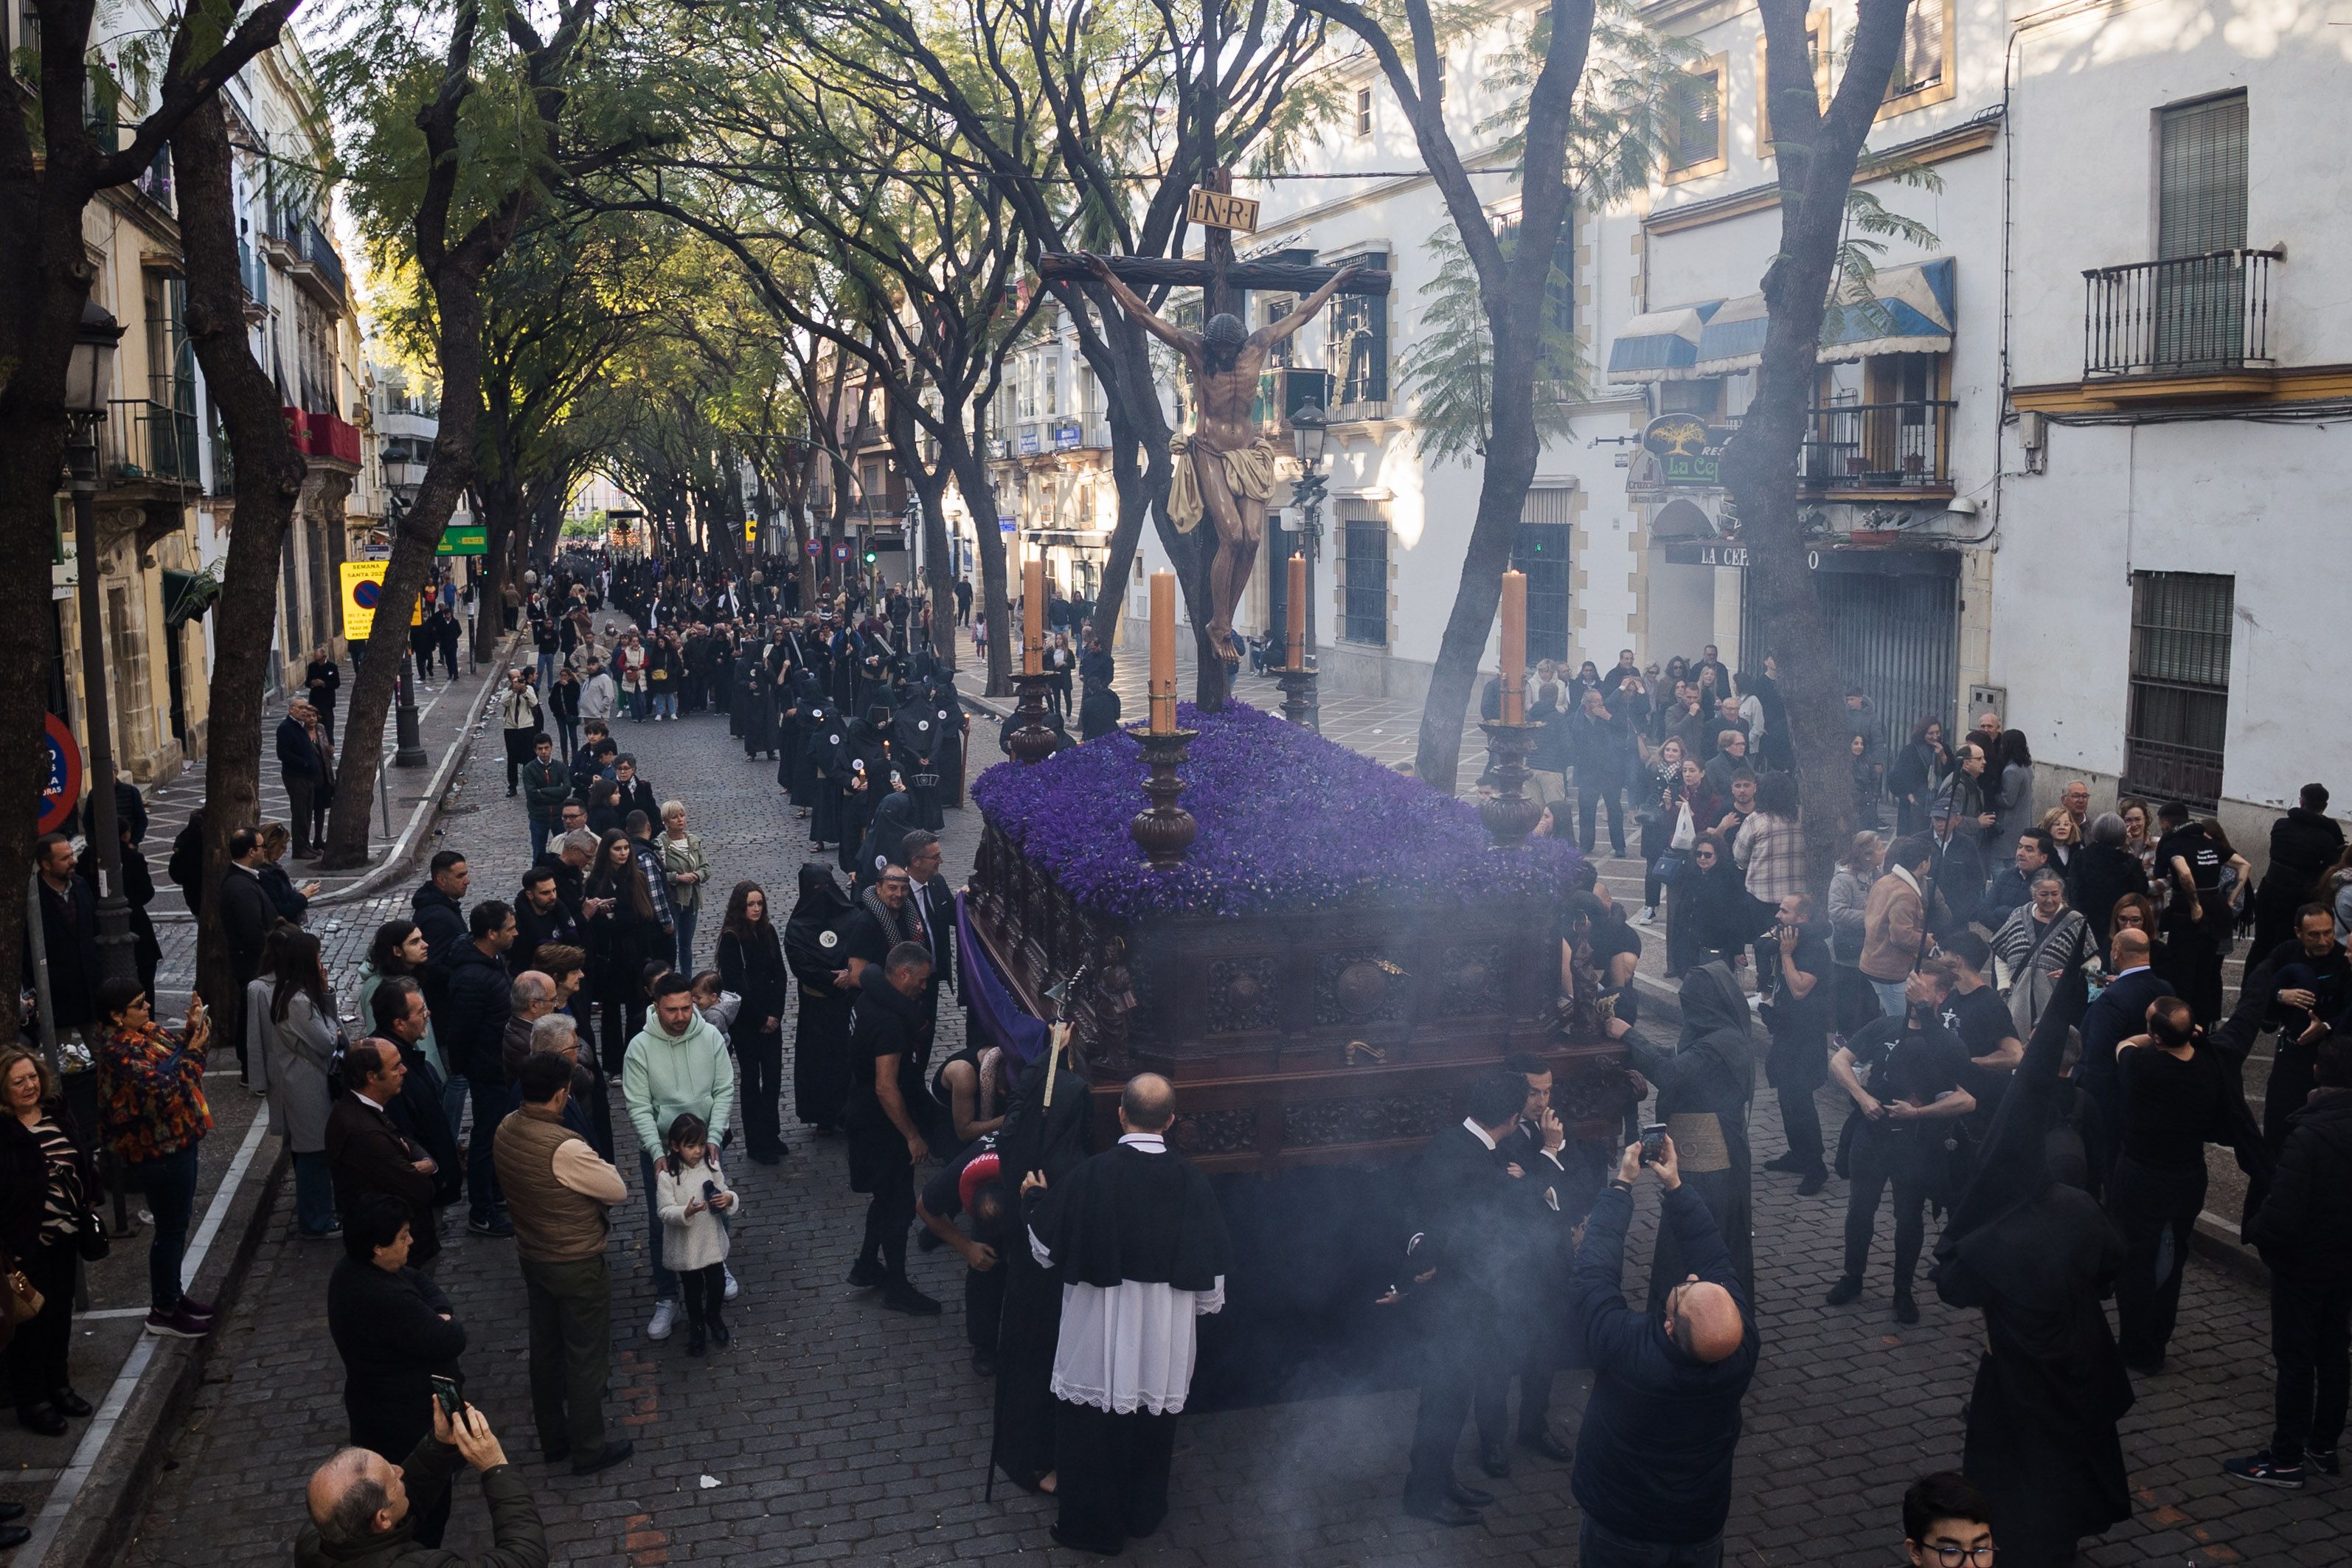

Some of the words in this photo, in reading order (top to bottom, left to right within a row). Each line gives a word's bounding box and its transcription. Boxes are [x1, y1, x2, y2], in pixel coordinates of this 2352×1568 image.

[1668, 457, 1689, 474] La
[1701, 547, 1716, 565] LA
[1724, 548, 1749, 566] CEP
